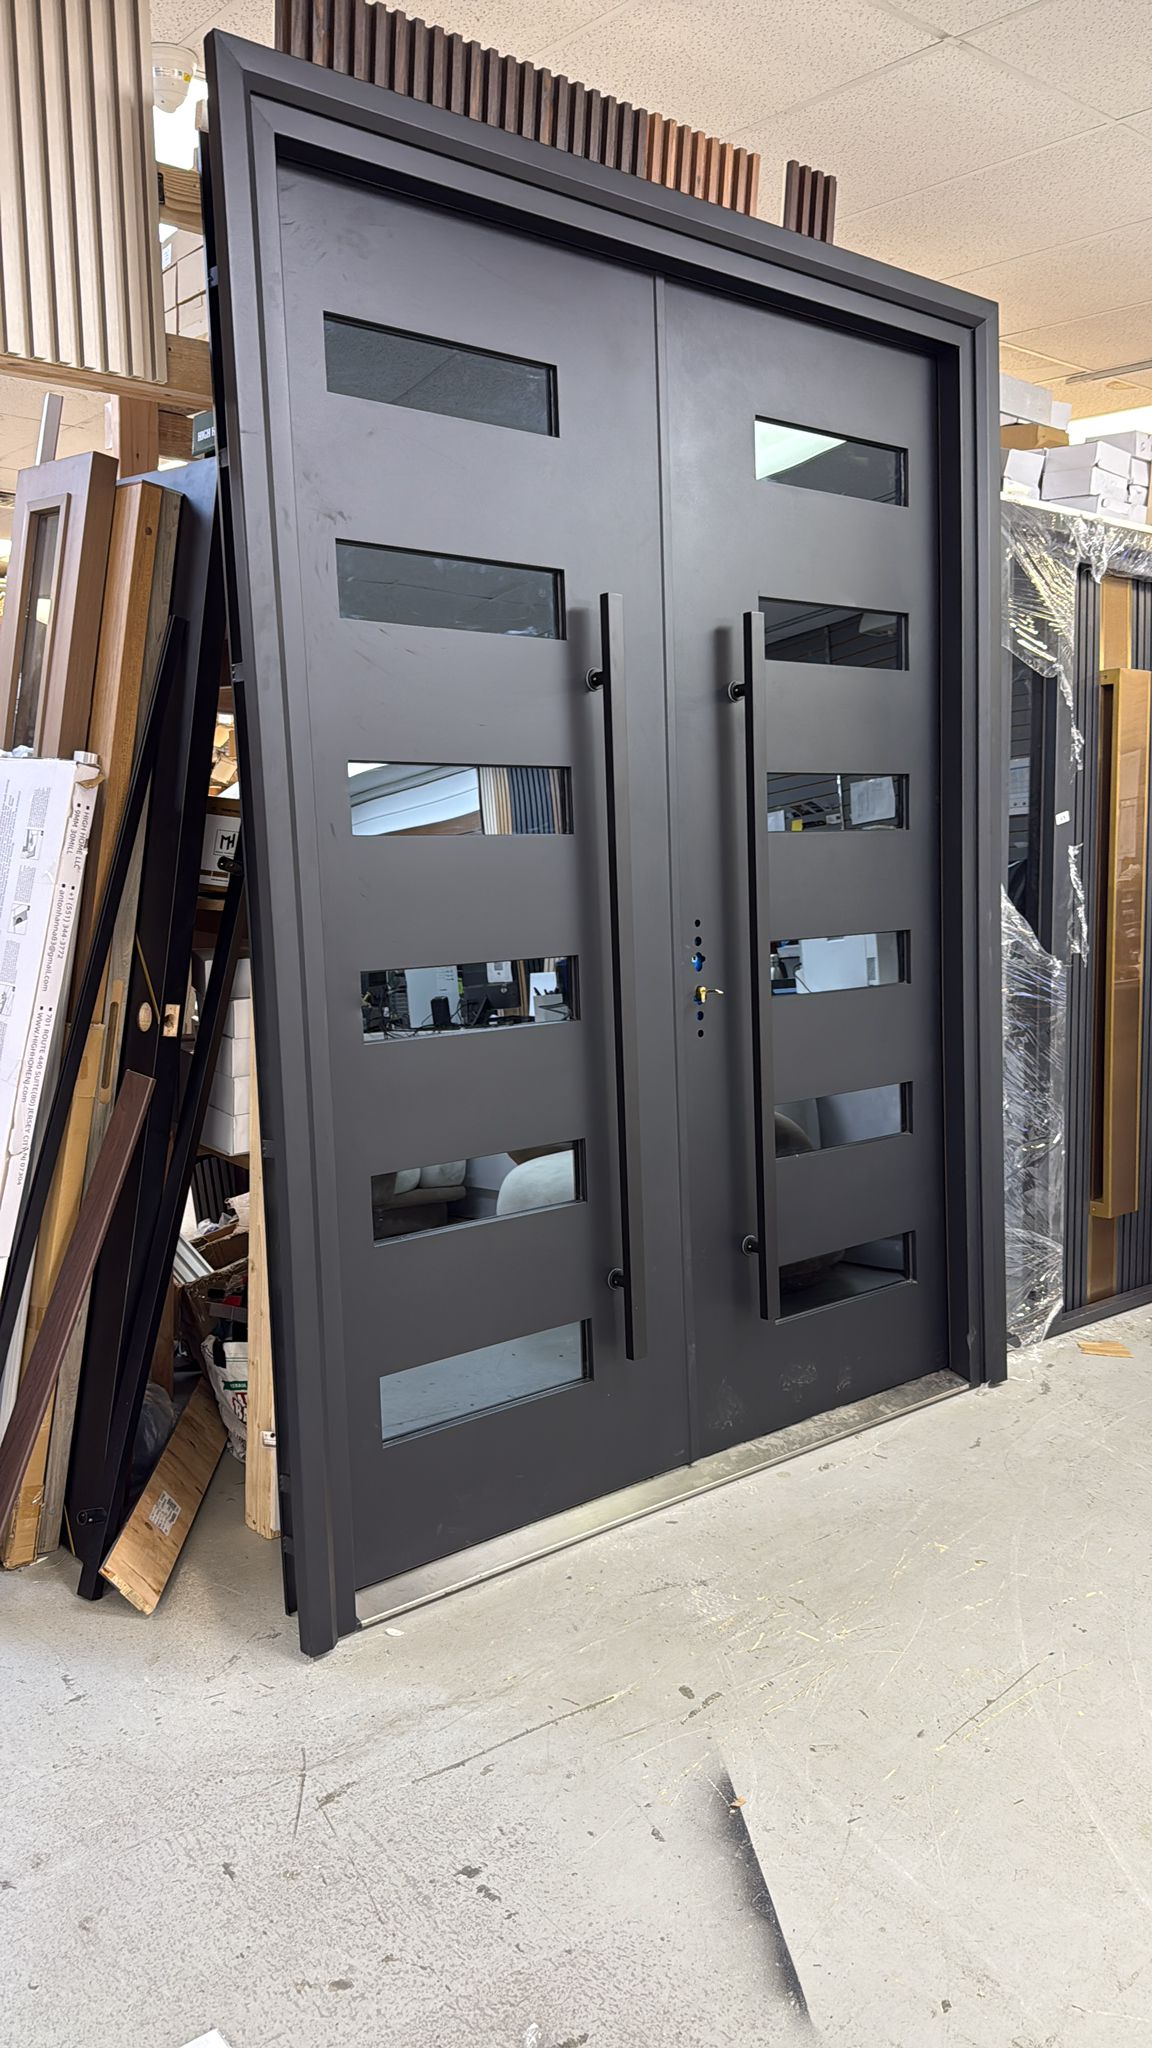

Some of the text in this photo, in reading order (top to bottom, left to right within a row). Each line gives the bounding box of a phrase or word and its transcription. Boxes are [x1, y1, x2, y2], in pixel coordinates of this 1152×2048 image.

[66, 809, 81, 855] 9MM 30MILL
[73, 811, 89, 869] HIGH HOME LLC
[56, 891, 75, 959] +1 (551) 344-3772
[43, 1013, 52, 1027] 701
[38, 1028, 48, 1054] ROUTE
[35, 1054, 44, 1070] 440
[24, 1107, 35, 1134] JERSEY
[19, 1152, 27, 1161] NJ
[16, 1161, 26, 1186] 07304
